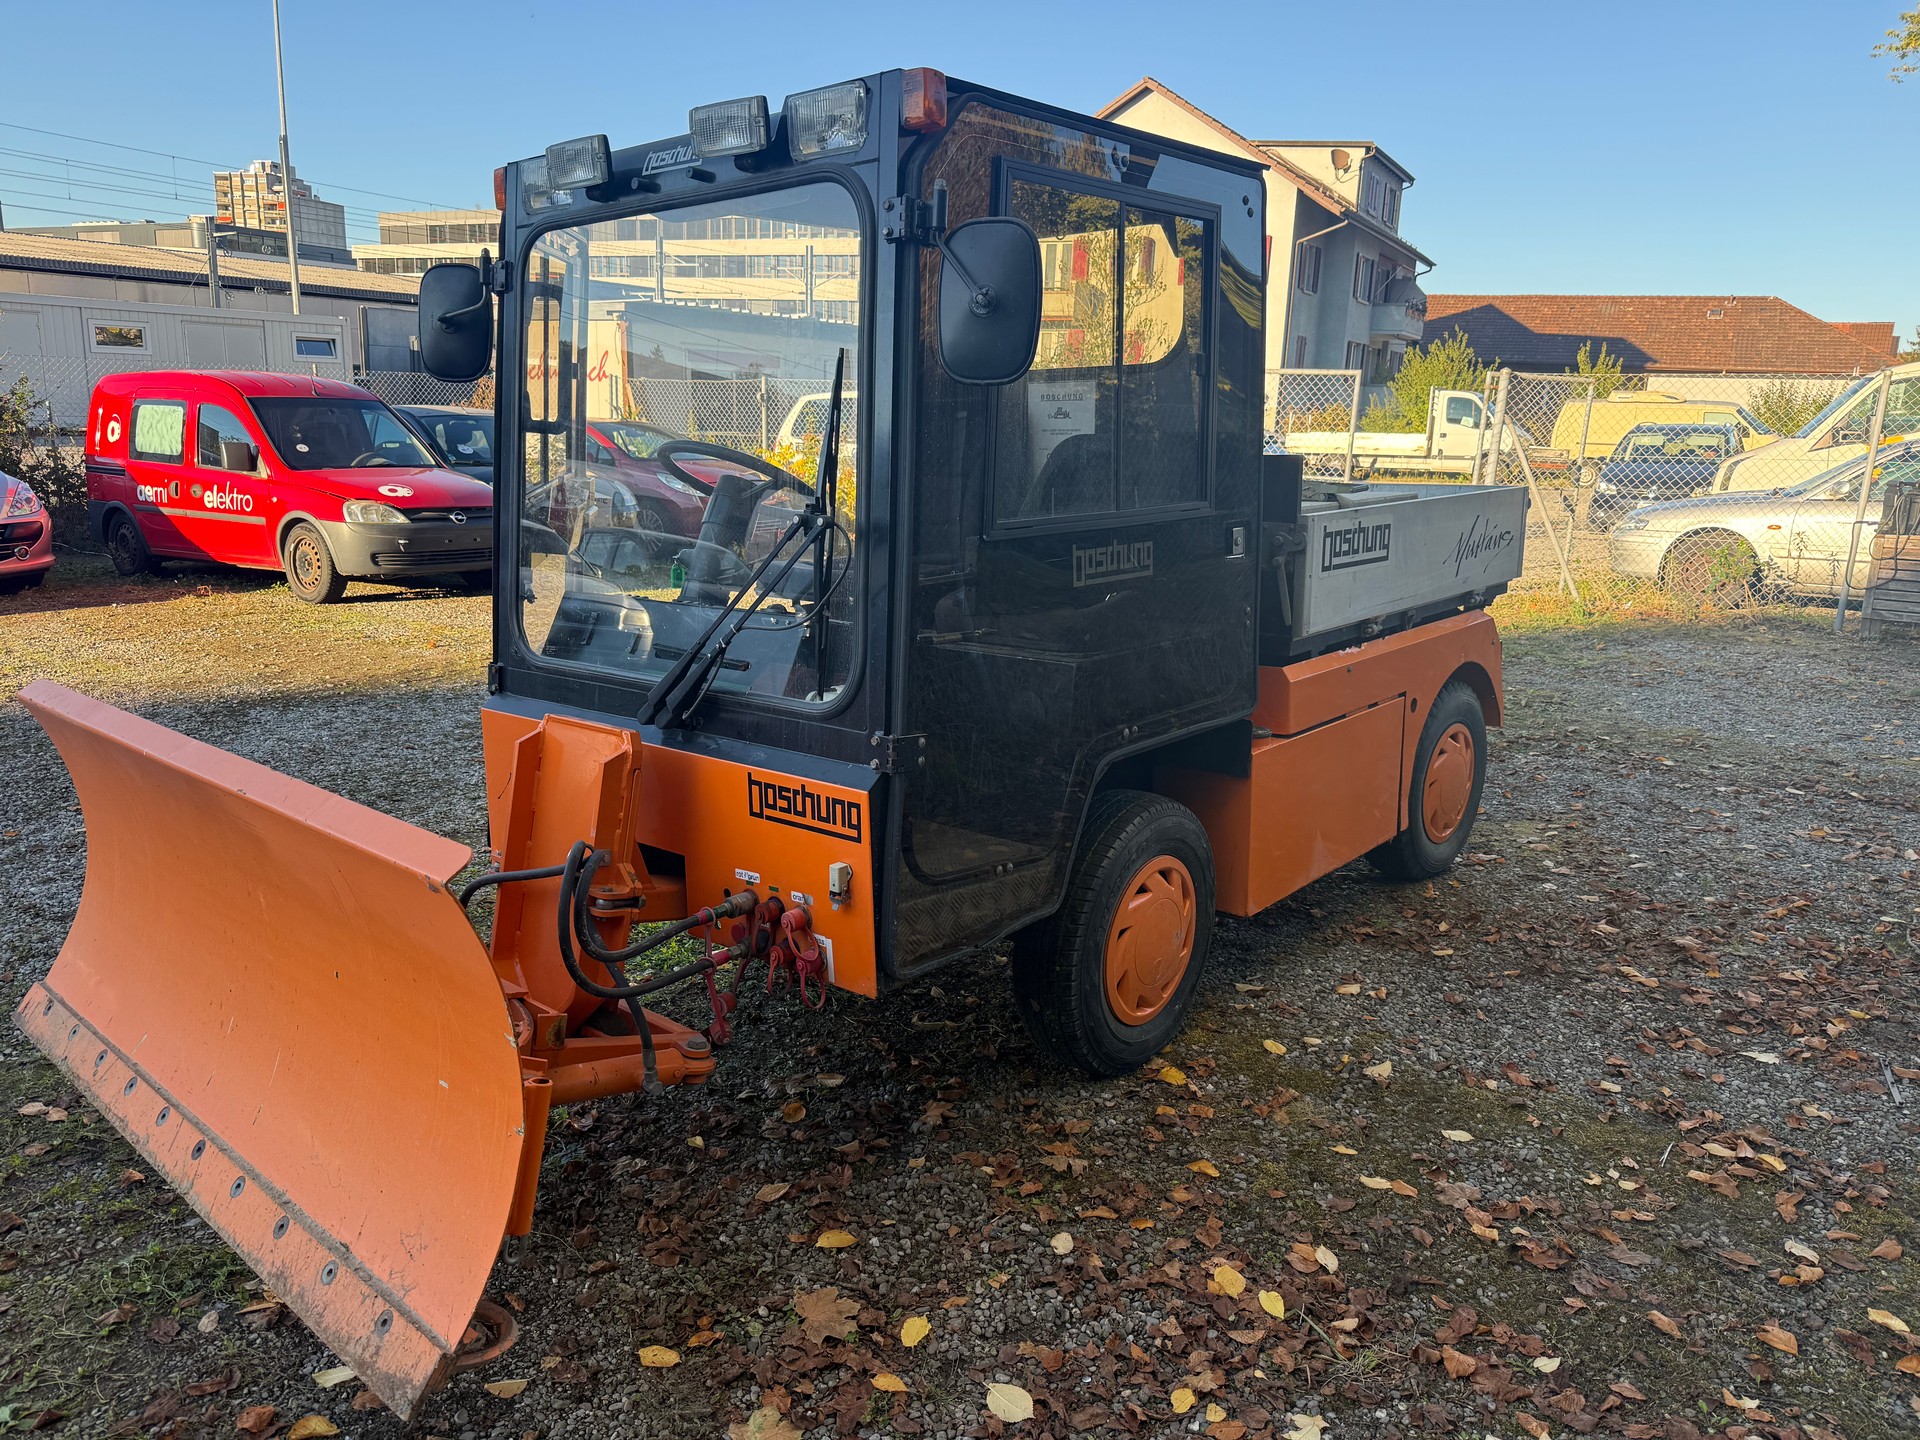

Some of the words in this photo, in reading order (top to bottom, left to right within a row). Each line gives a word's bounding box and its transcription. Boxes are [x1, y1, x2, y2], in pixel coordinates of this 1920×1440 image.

[1040, 392, 1083, 400] BOSCHUNG
[136, 479, 168, 504] aerni
[203, 481, 253, 512] elektro
[1072, 539, 1154, 588] boschung
[1321, 521, 1391, 573] boschung
[747, 771, 861, 844] boschung
